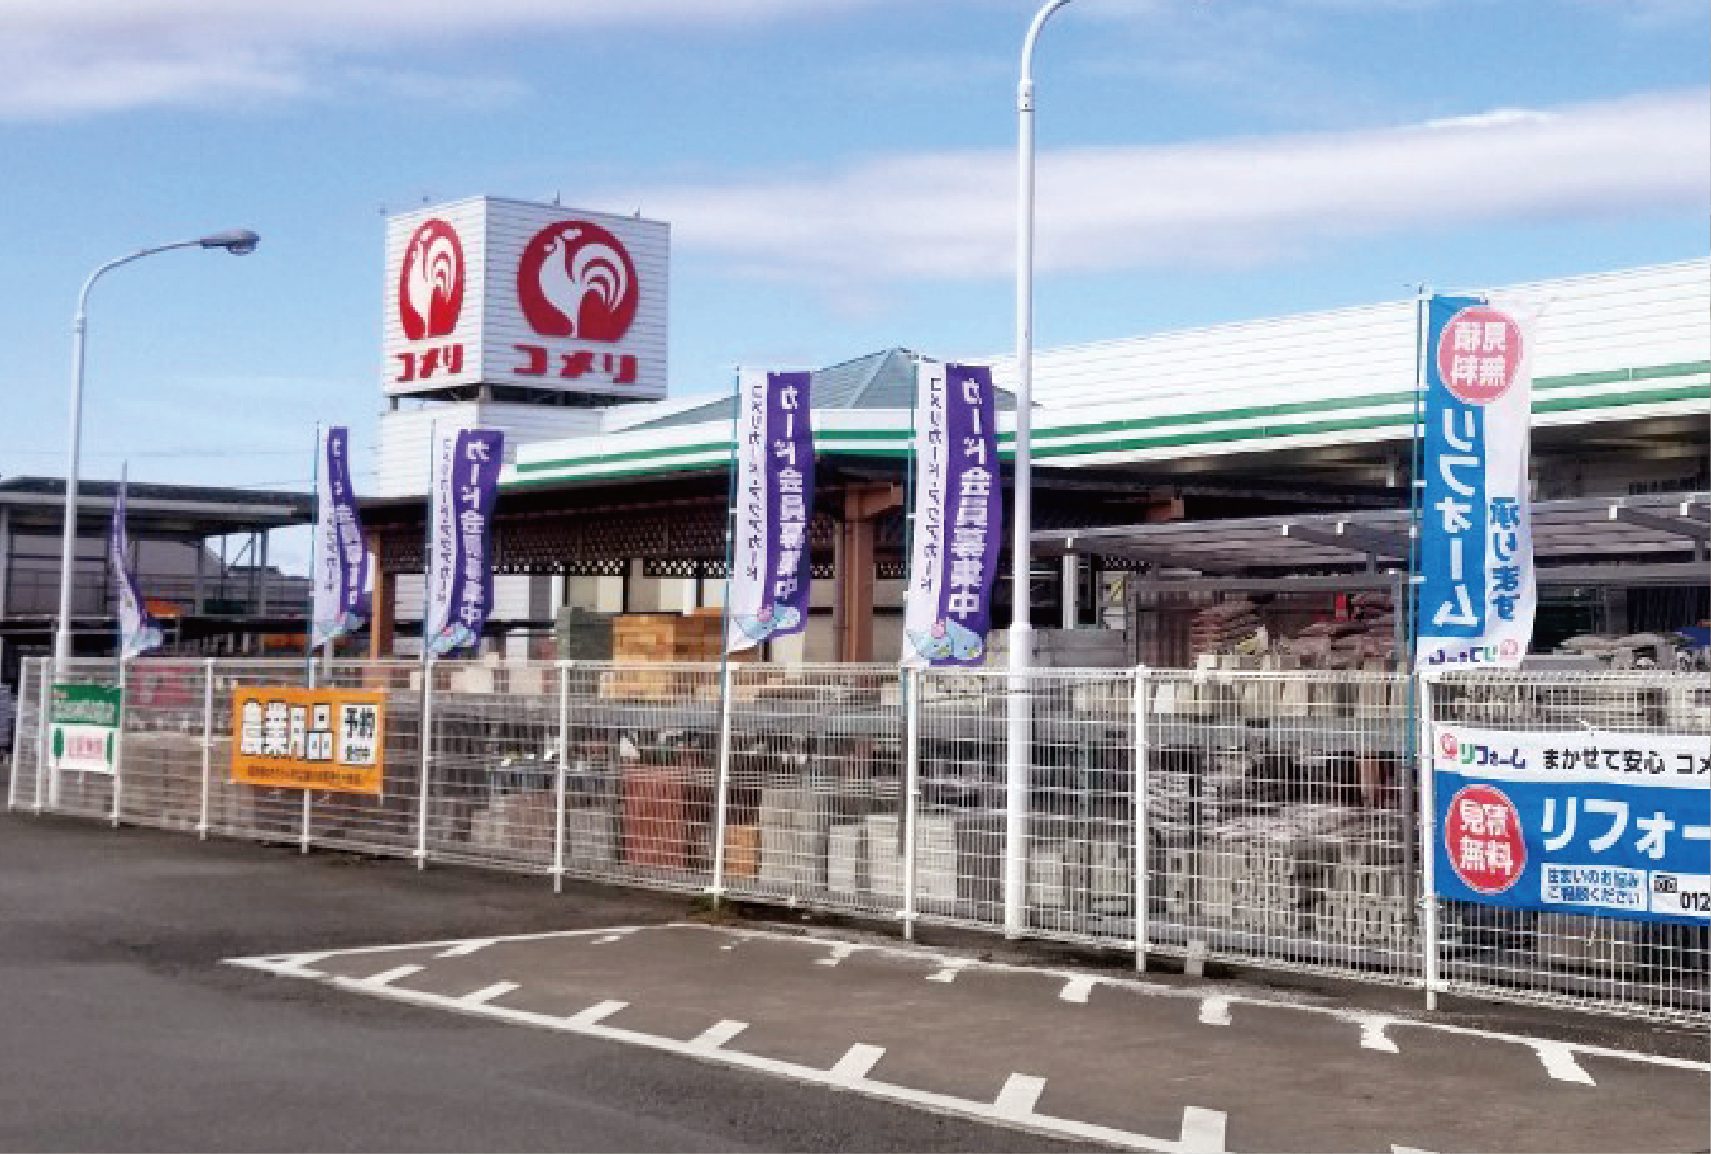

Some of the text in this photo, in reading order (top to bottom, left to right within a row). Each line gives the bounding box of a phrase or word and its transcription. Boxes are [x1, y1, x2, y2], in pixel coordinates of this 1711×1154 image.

[394, 344, 463, 382] コメリ
[512, 344, 638, 384] コメリ
[1460, 744, 1526, 769] リフォーム
[1543, 747, 1666, 775] まかせて安心
[1541, 797, 1711, 860] リフォー
